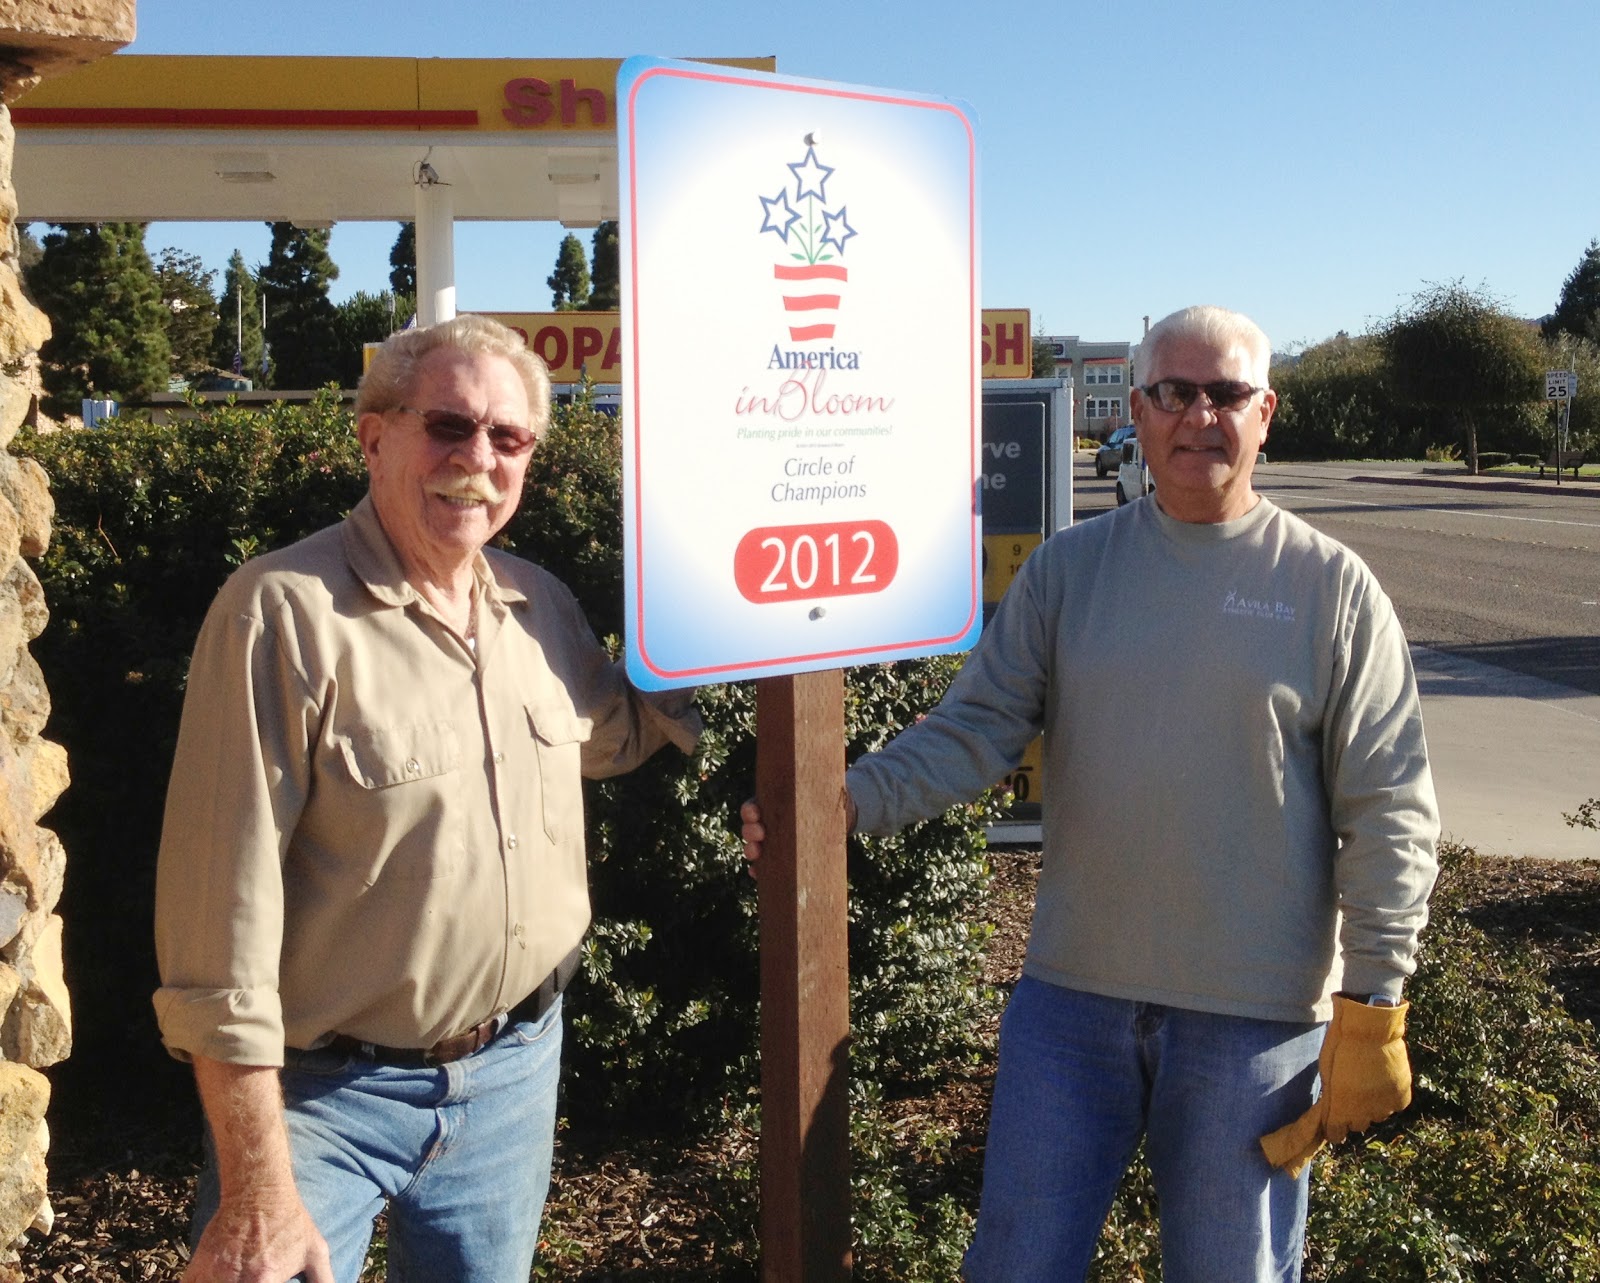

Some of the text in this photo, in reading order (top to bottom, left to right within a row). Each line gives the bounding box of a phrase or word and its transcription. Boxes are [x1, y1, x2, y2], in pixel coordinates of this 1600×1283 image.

[767, 344, 860, 370] America
[1548, 386, 1567, 397] 25
[736, 424, 893, 441] Planting pride in our communities!
[784, 455, 856, 477] Circle of
[771, 481, 867, 505] Champions
[760, 530, 877, 592] 2012
[1012, 544, 1021, 556] 9
